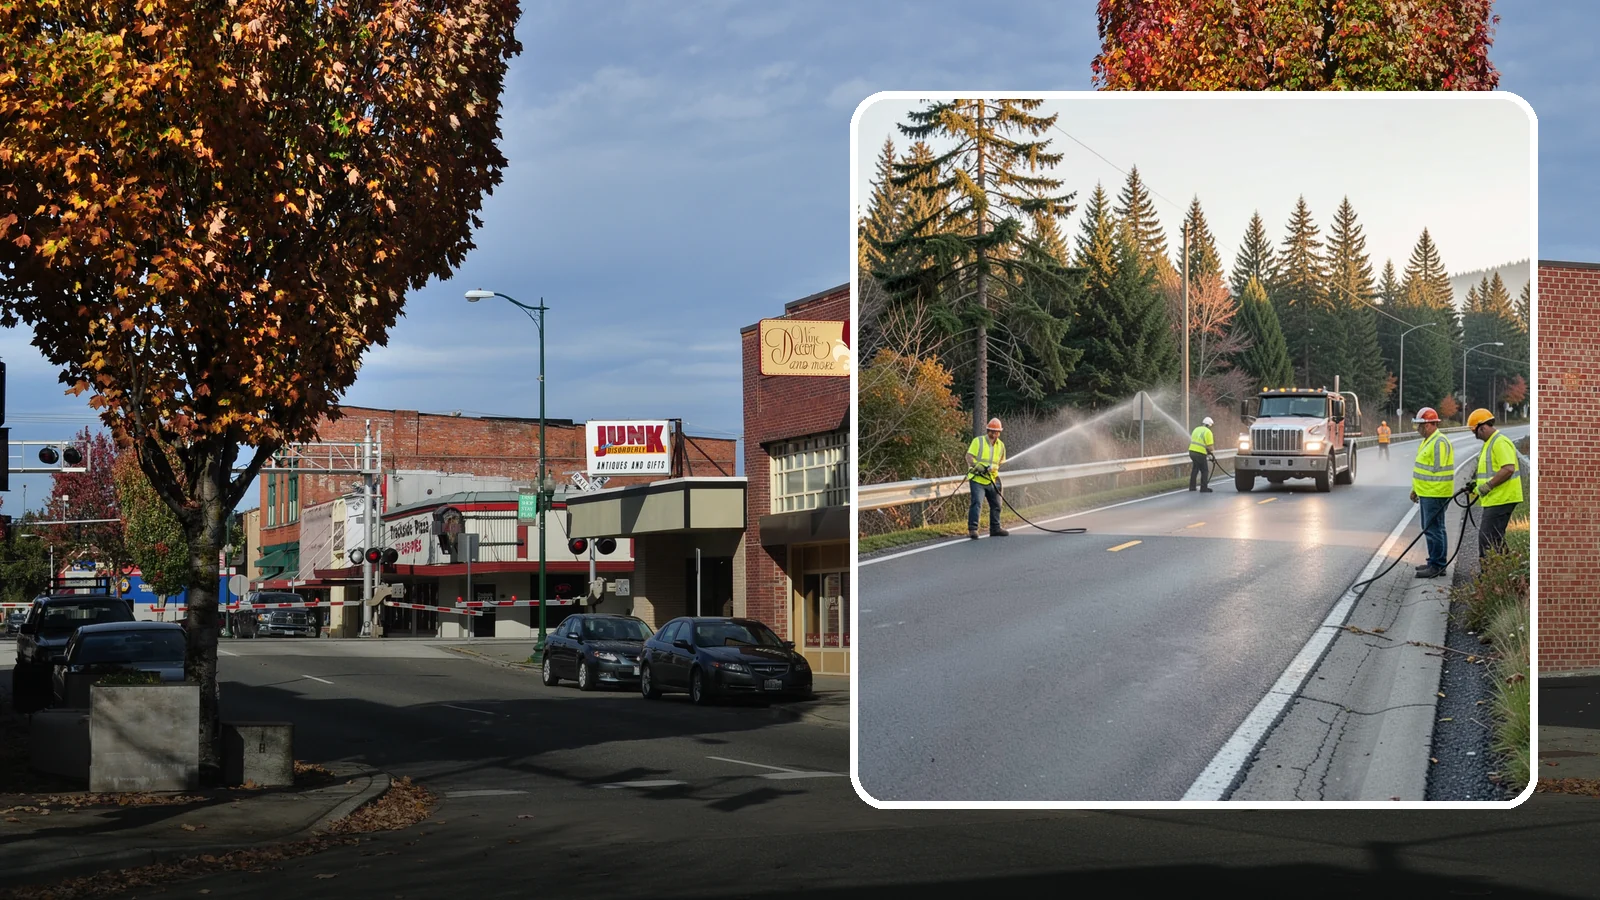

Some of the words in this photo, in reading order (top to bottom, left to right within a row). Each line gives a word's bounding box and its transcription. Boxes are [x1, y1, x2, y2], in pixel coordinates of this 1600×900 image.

[765, 327, 831, 365] Decor
[595, 425, 666, 457] JUNK
[607, 446, 645, 454] DISORDERLY
[597, 461, 628, 470] ANTIQUES
[631, 461, 644, 470] AND
[647, 460, 665, 469] GIFTS
[414, 519, 429, 535] Pizza
